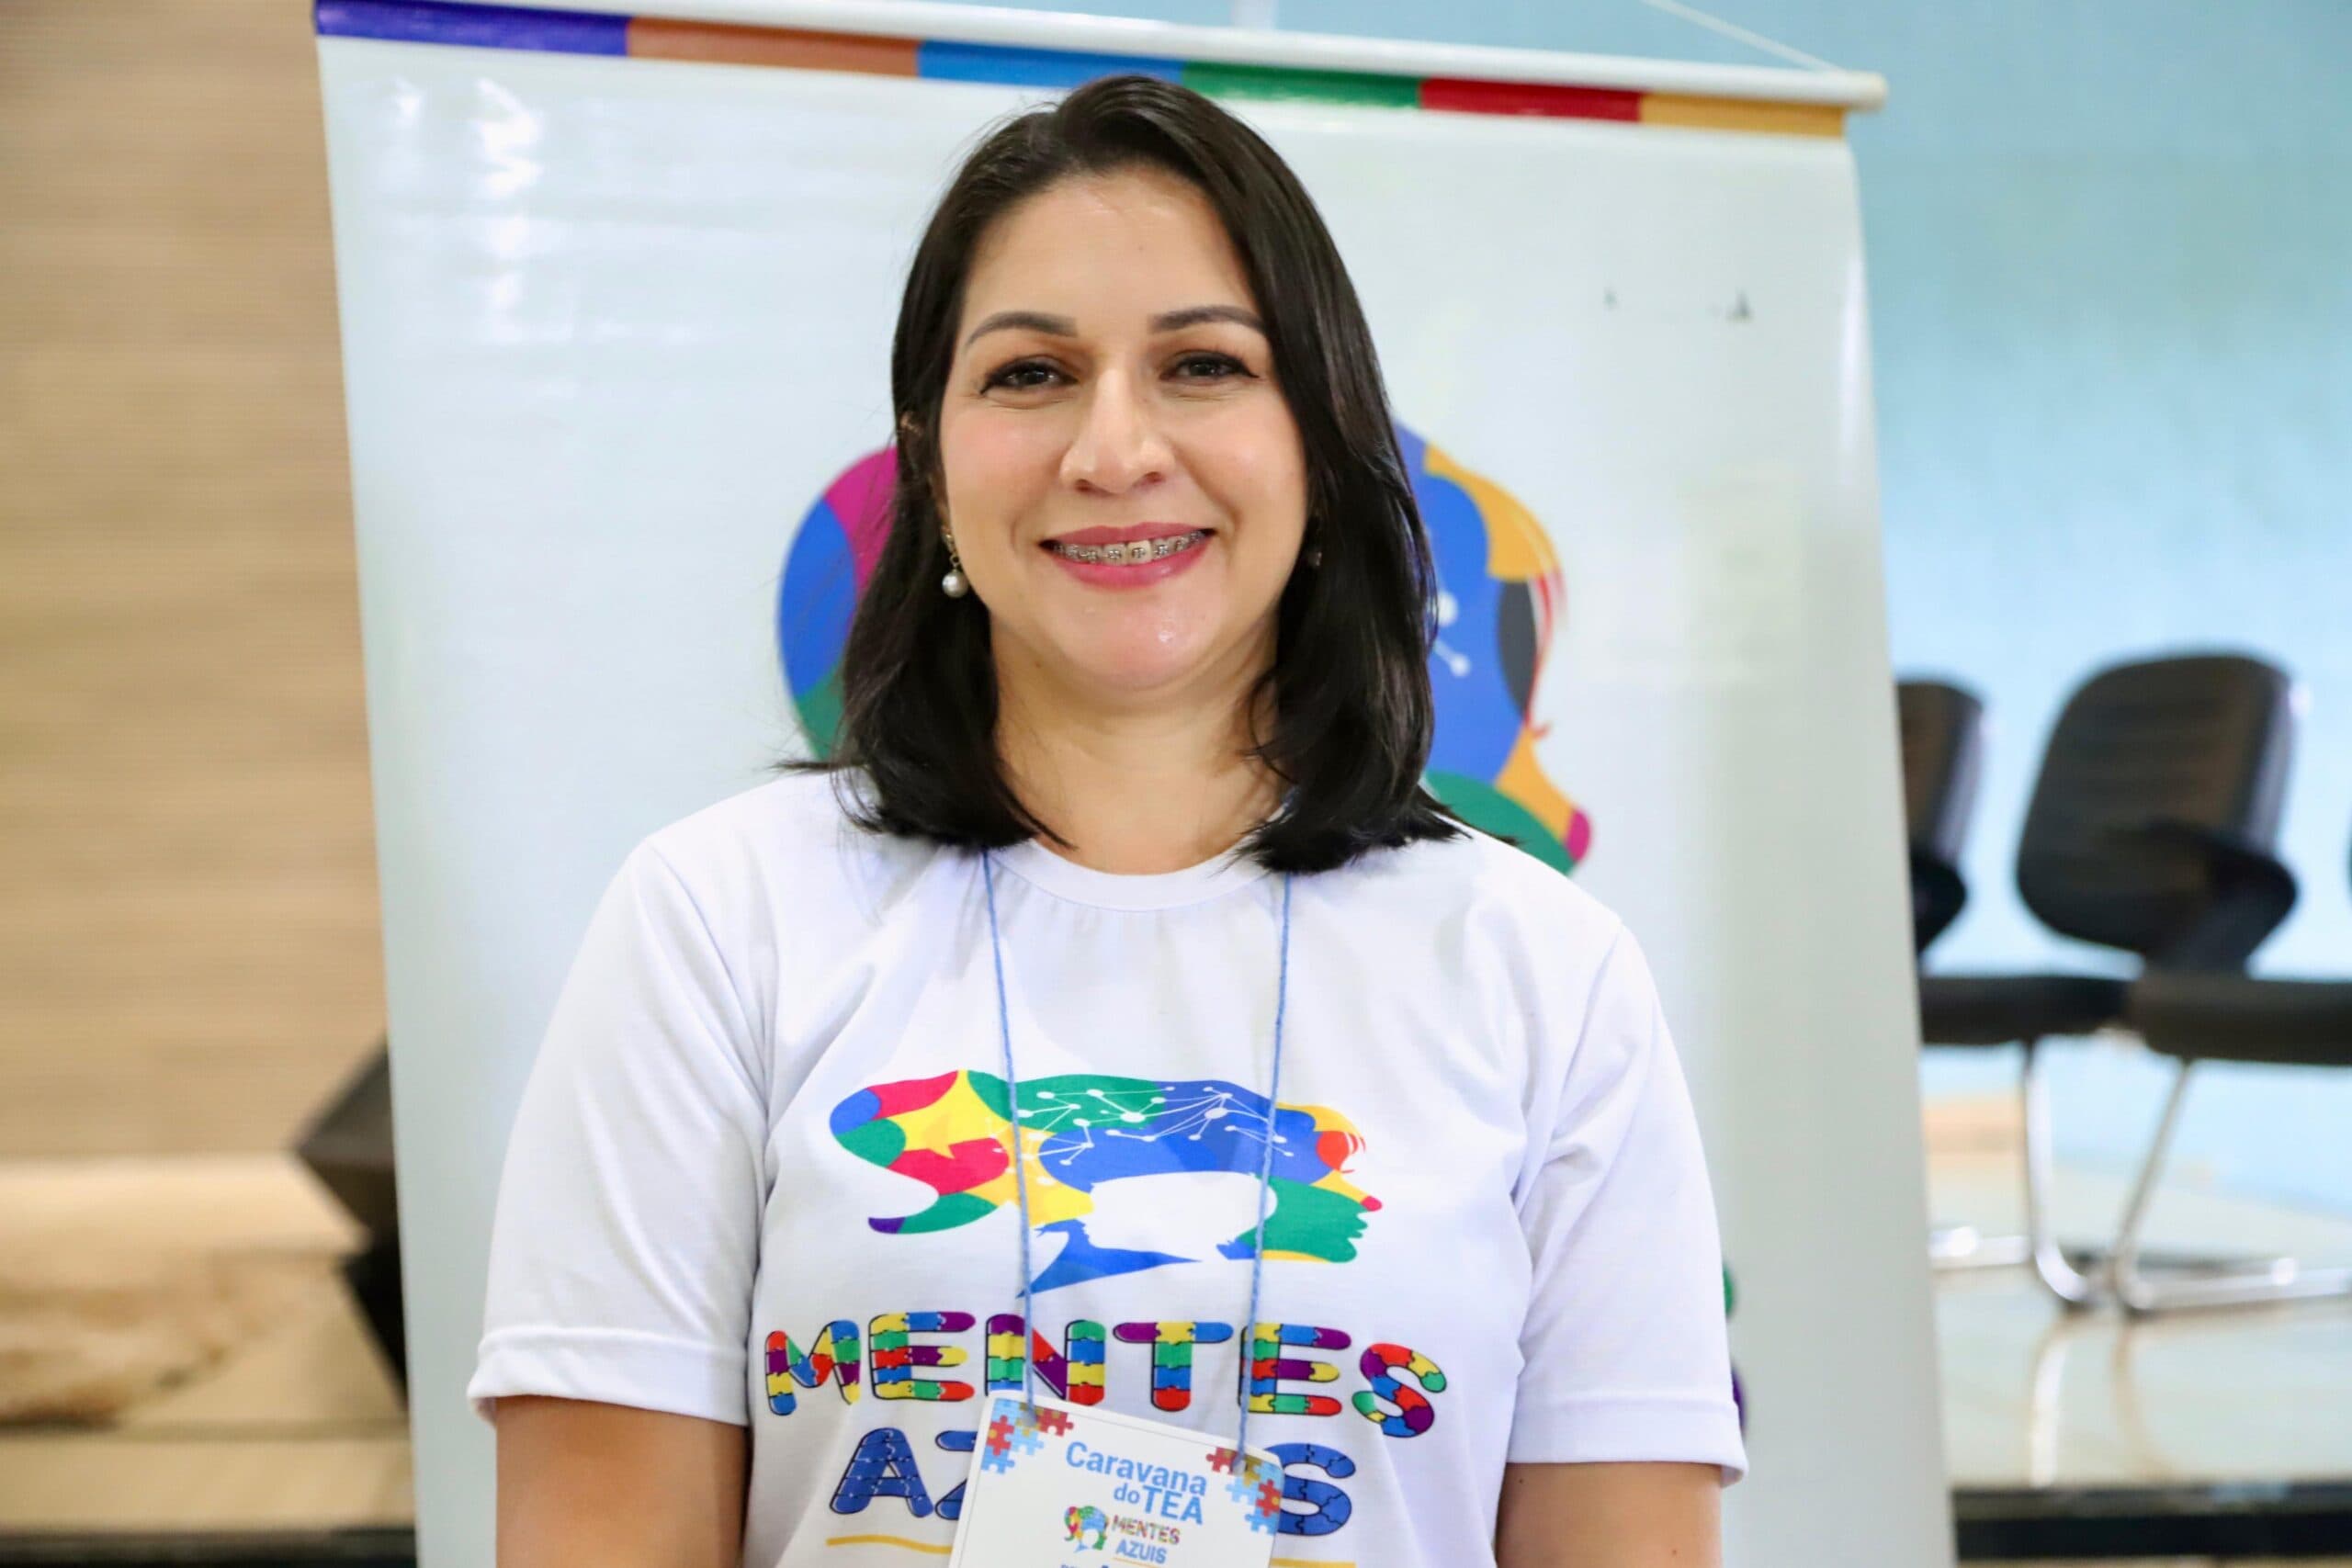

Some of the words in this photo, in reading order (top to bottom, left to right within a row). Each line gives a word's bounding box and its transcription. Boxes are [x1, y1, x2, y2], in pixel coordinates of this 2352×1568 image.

[764, 1311, 1448, 1438] MENTES
[1065, 1440, 1208, 1497] Caravana
[1113, 1482, 1141, 1506] do
[1142, 1484, 1204, 1525] TEA
[1112, 1514, 1182, 1545] MENTES
[1115, 1539, 1168, 1564] AZUIS
